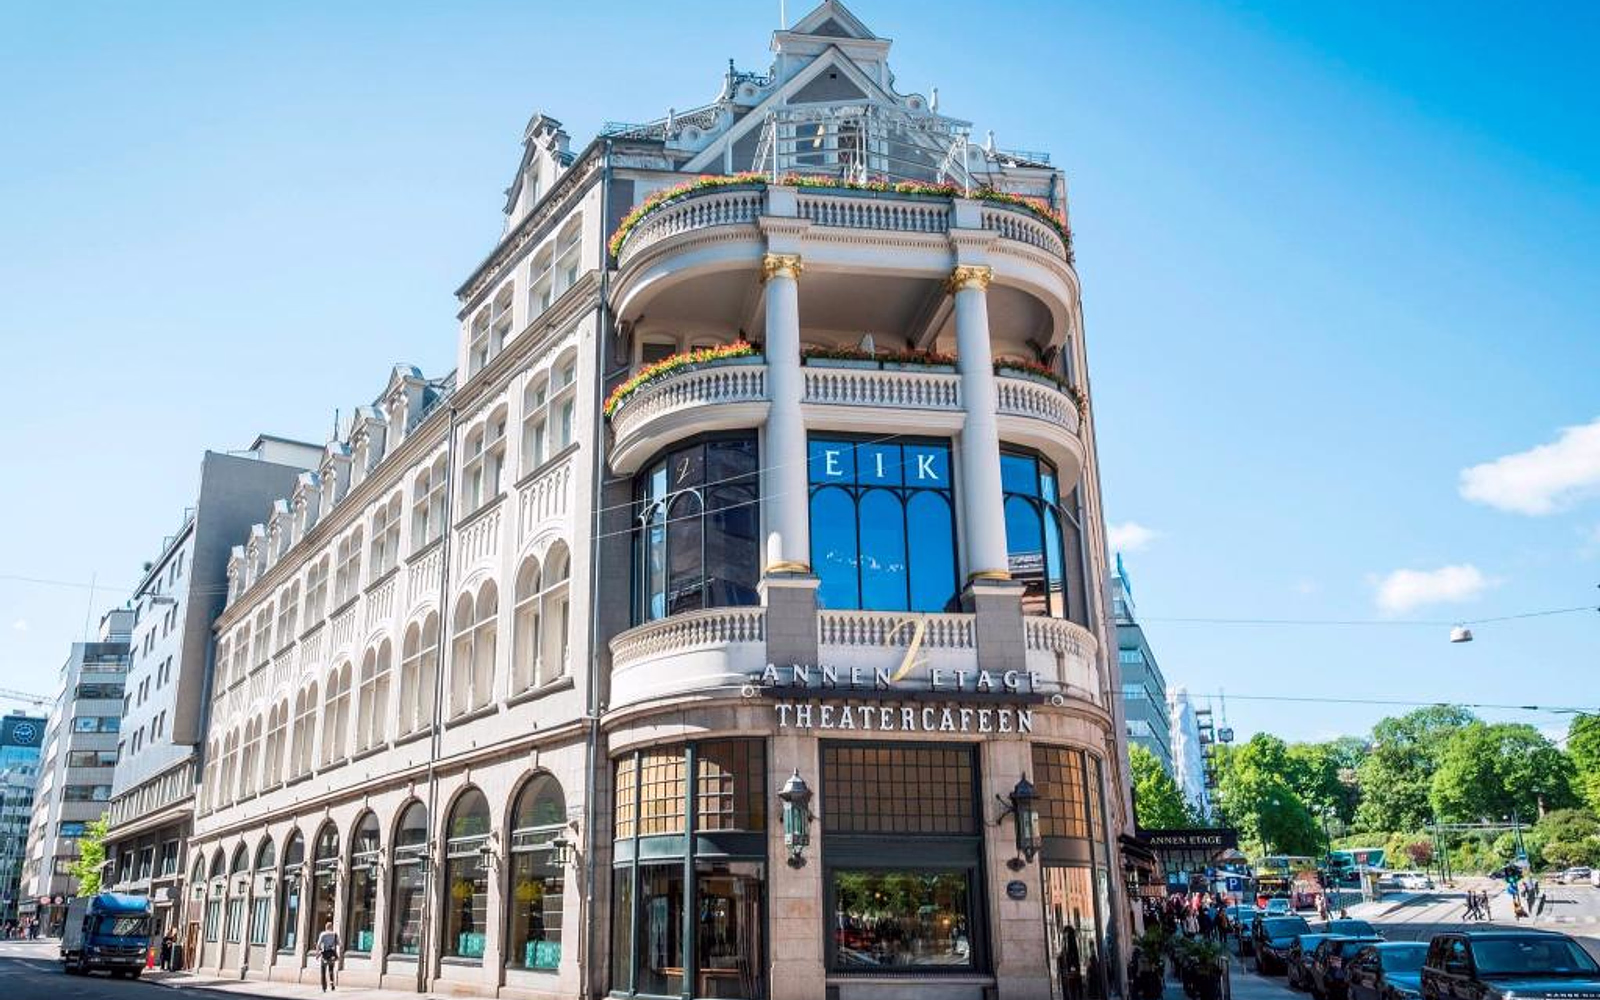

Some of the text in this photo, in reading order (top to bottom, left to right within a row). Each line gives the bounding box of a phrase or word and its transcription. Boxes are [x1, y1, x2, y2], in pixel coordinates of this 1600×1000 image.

[825, 450, 939, 479] EIK
[762, 663, 891, 686] ANNEN
[932, 668, 1041, 689] ETAGE
[774, 704, 1033, 733] THEATERCAFEEN
[1150, 836, 1223, 845] ANNEN ETAGE
[1229, 878, 1238, 890] P
